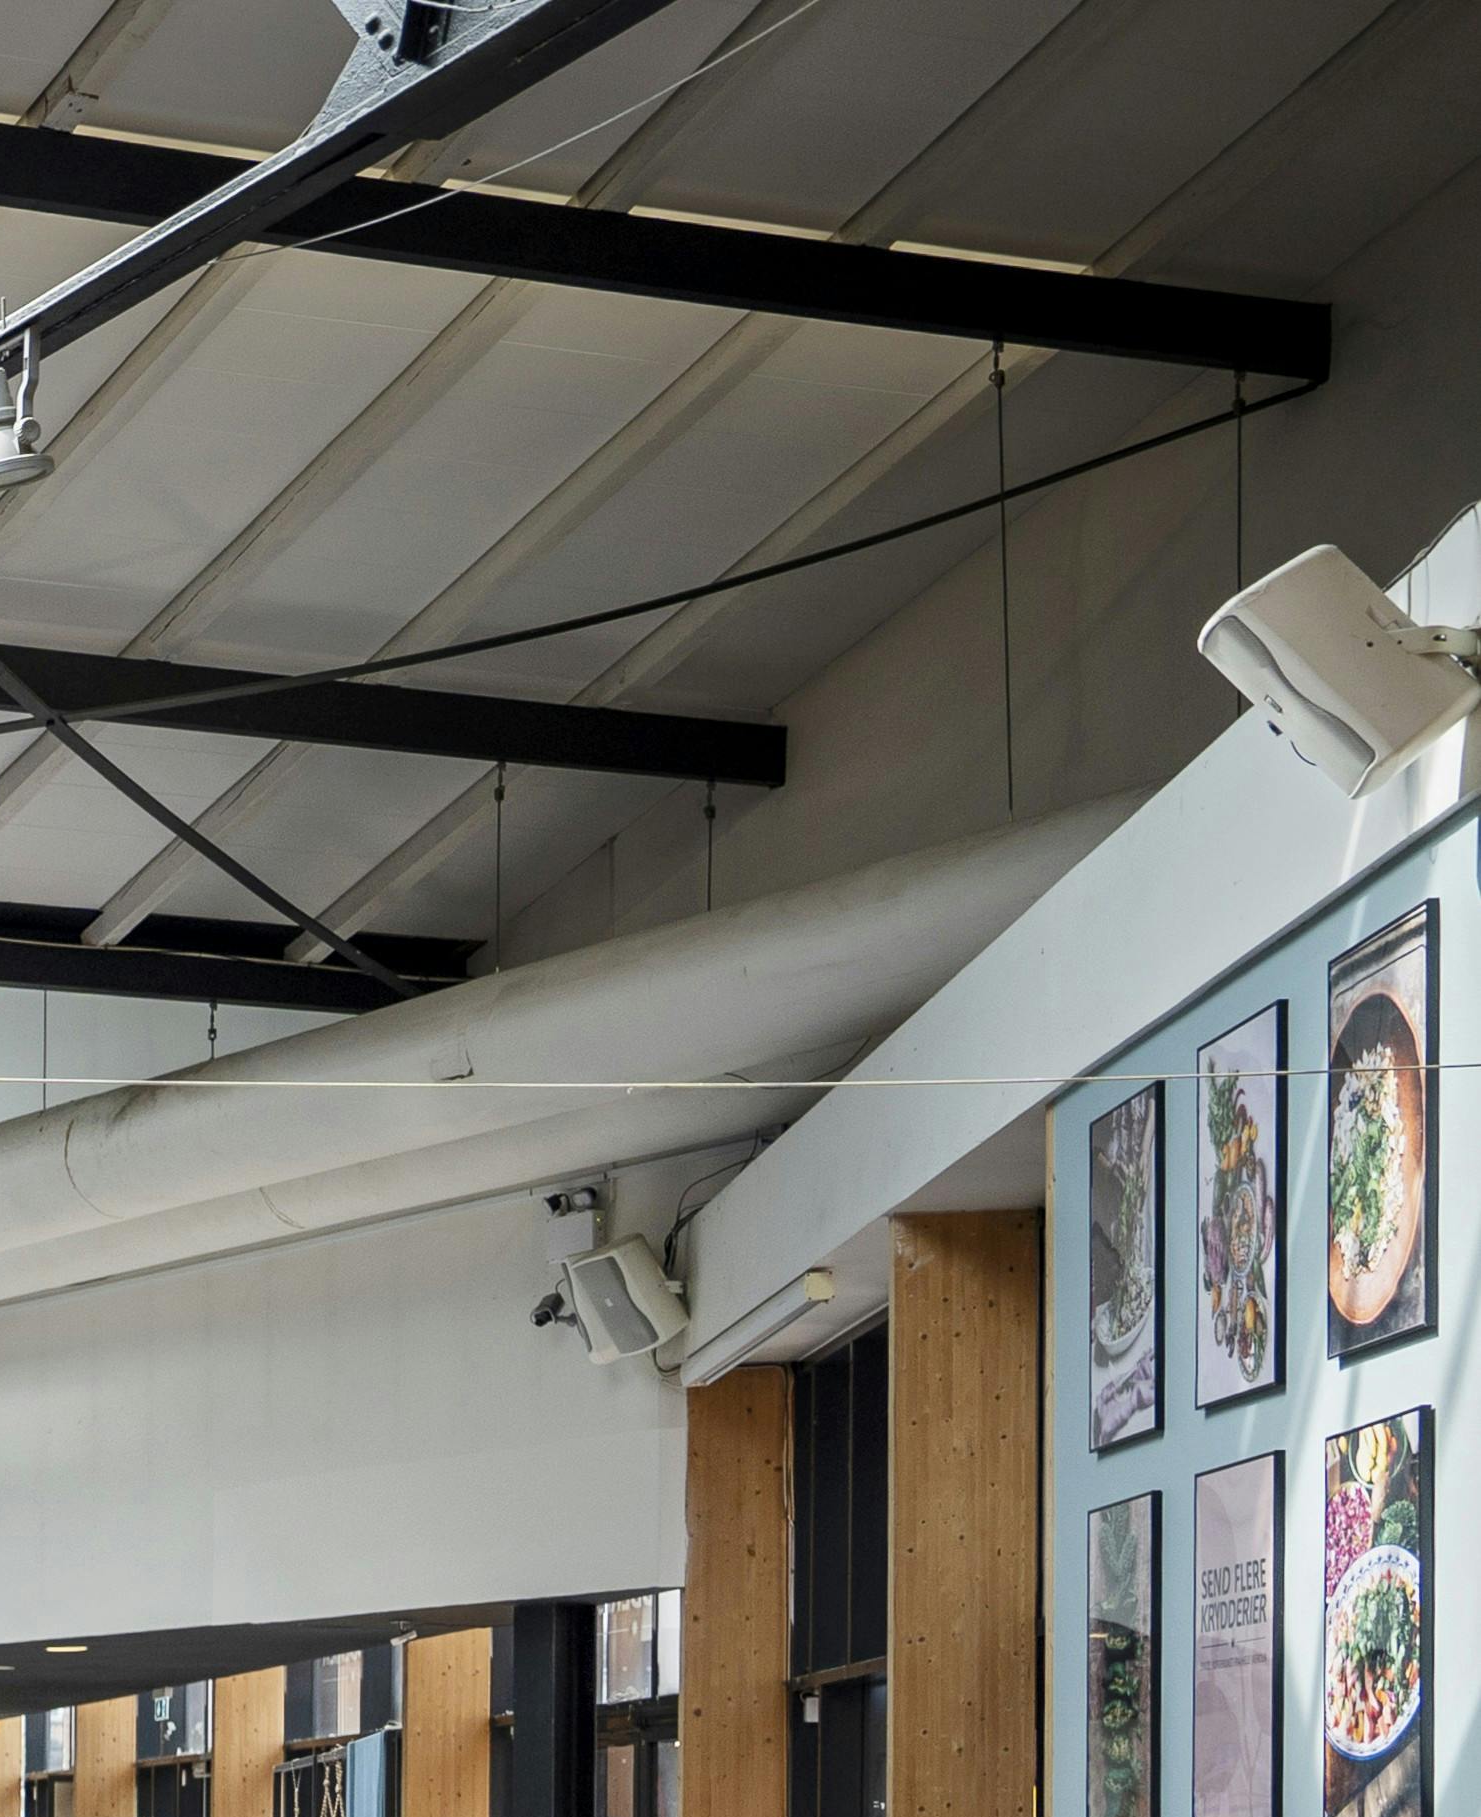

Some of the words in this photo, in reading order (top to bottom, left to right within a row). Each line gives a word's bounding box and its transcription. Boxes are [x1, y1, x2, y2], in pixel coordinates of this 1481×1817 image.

[1201, 1567, 1231, 1599] SEND
[1234, 1558, 1267, 1593] FLERE
[1200, 1593, 1268, 1632] KRYDDERIER
